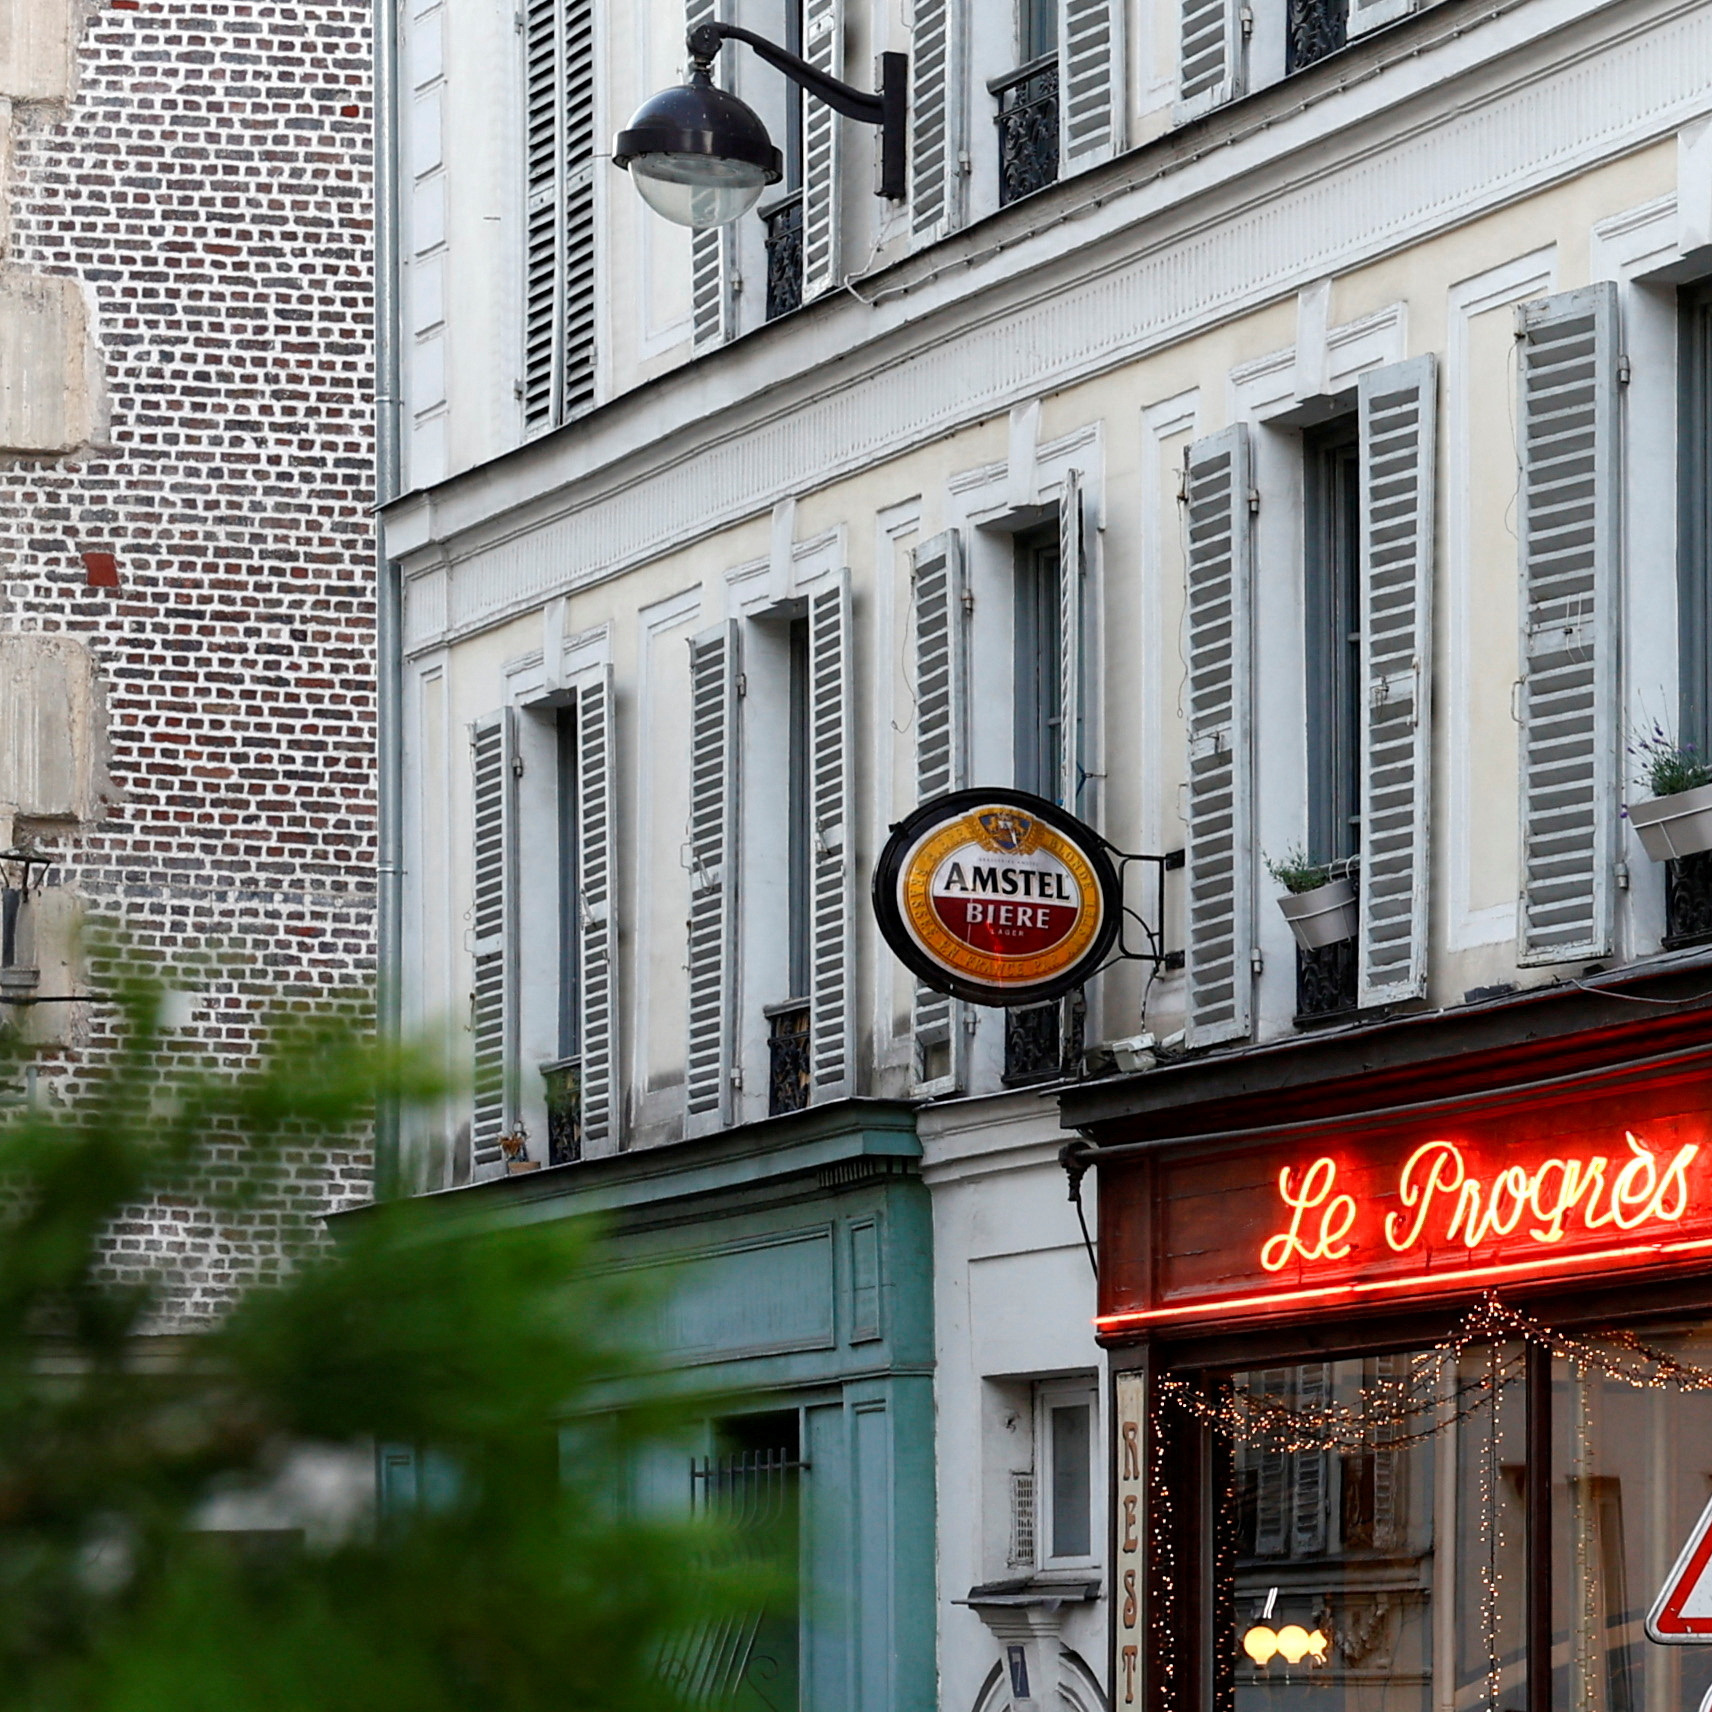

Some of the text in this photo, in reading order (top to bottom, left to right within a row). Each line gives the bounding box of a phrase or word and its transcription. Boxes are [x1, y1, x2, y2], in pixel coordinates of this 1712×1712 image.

[944, 861, 1071, 901] AMSTEL
[966, 902, 1051, 930] BIERE
[1259, 1130, 1699, 1272] Le Progrès
